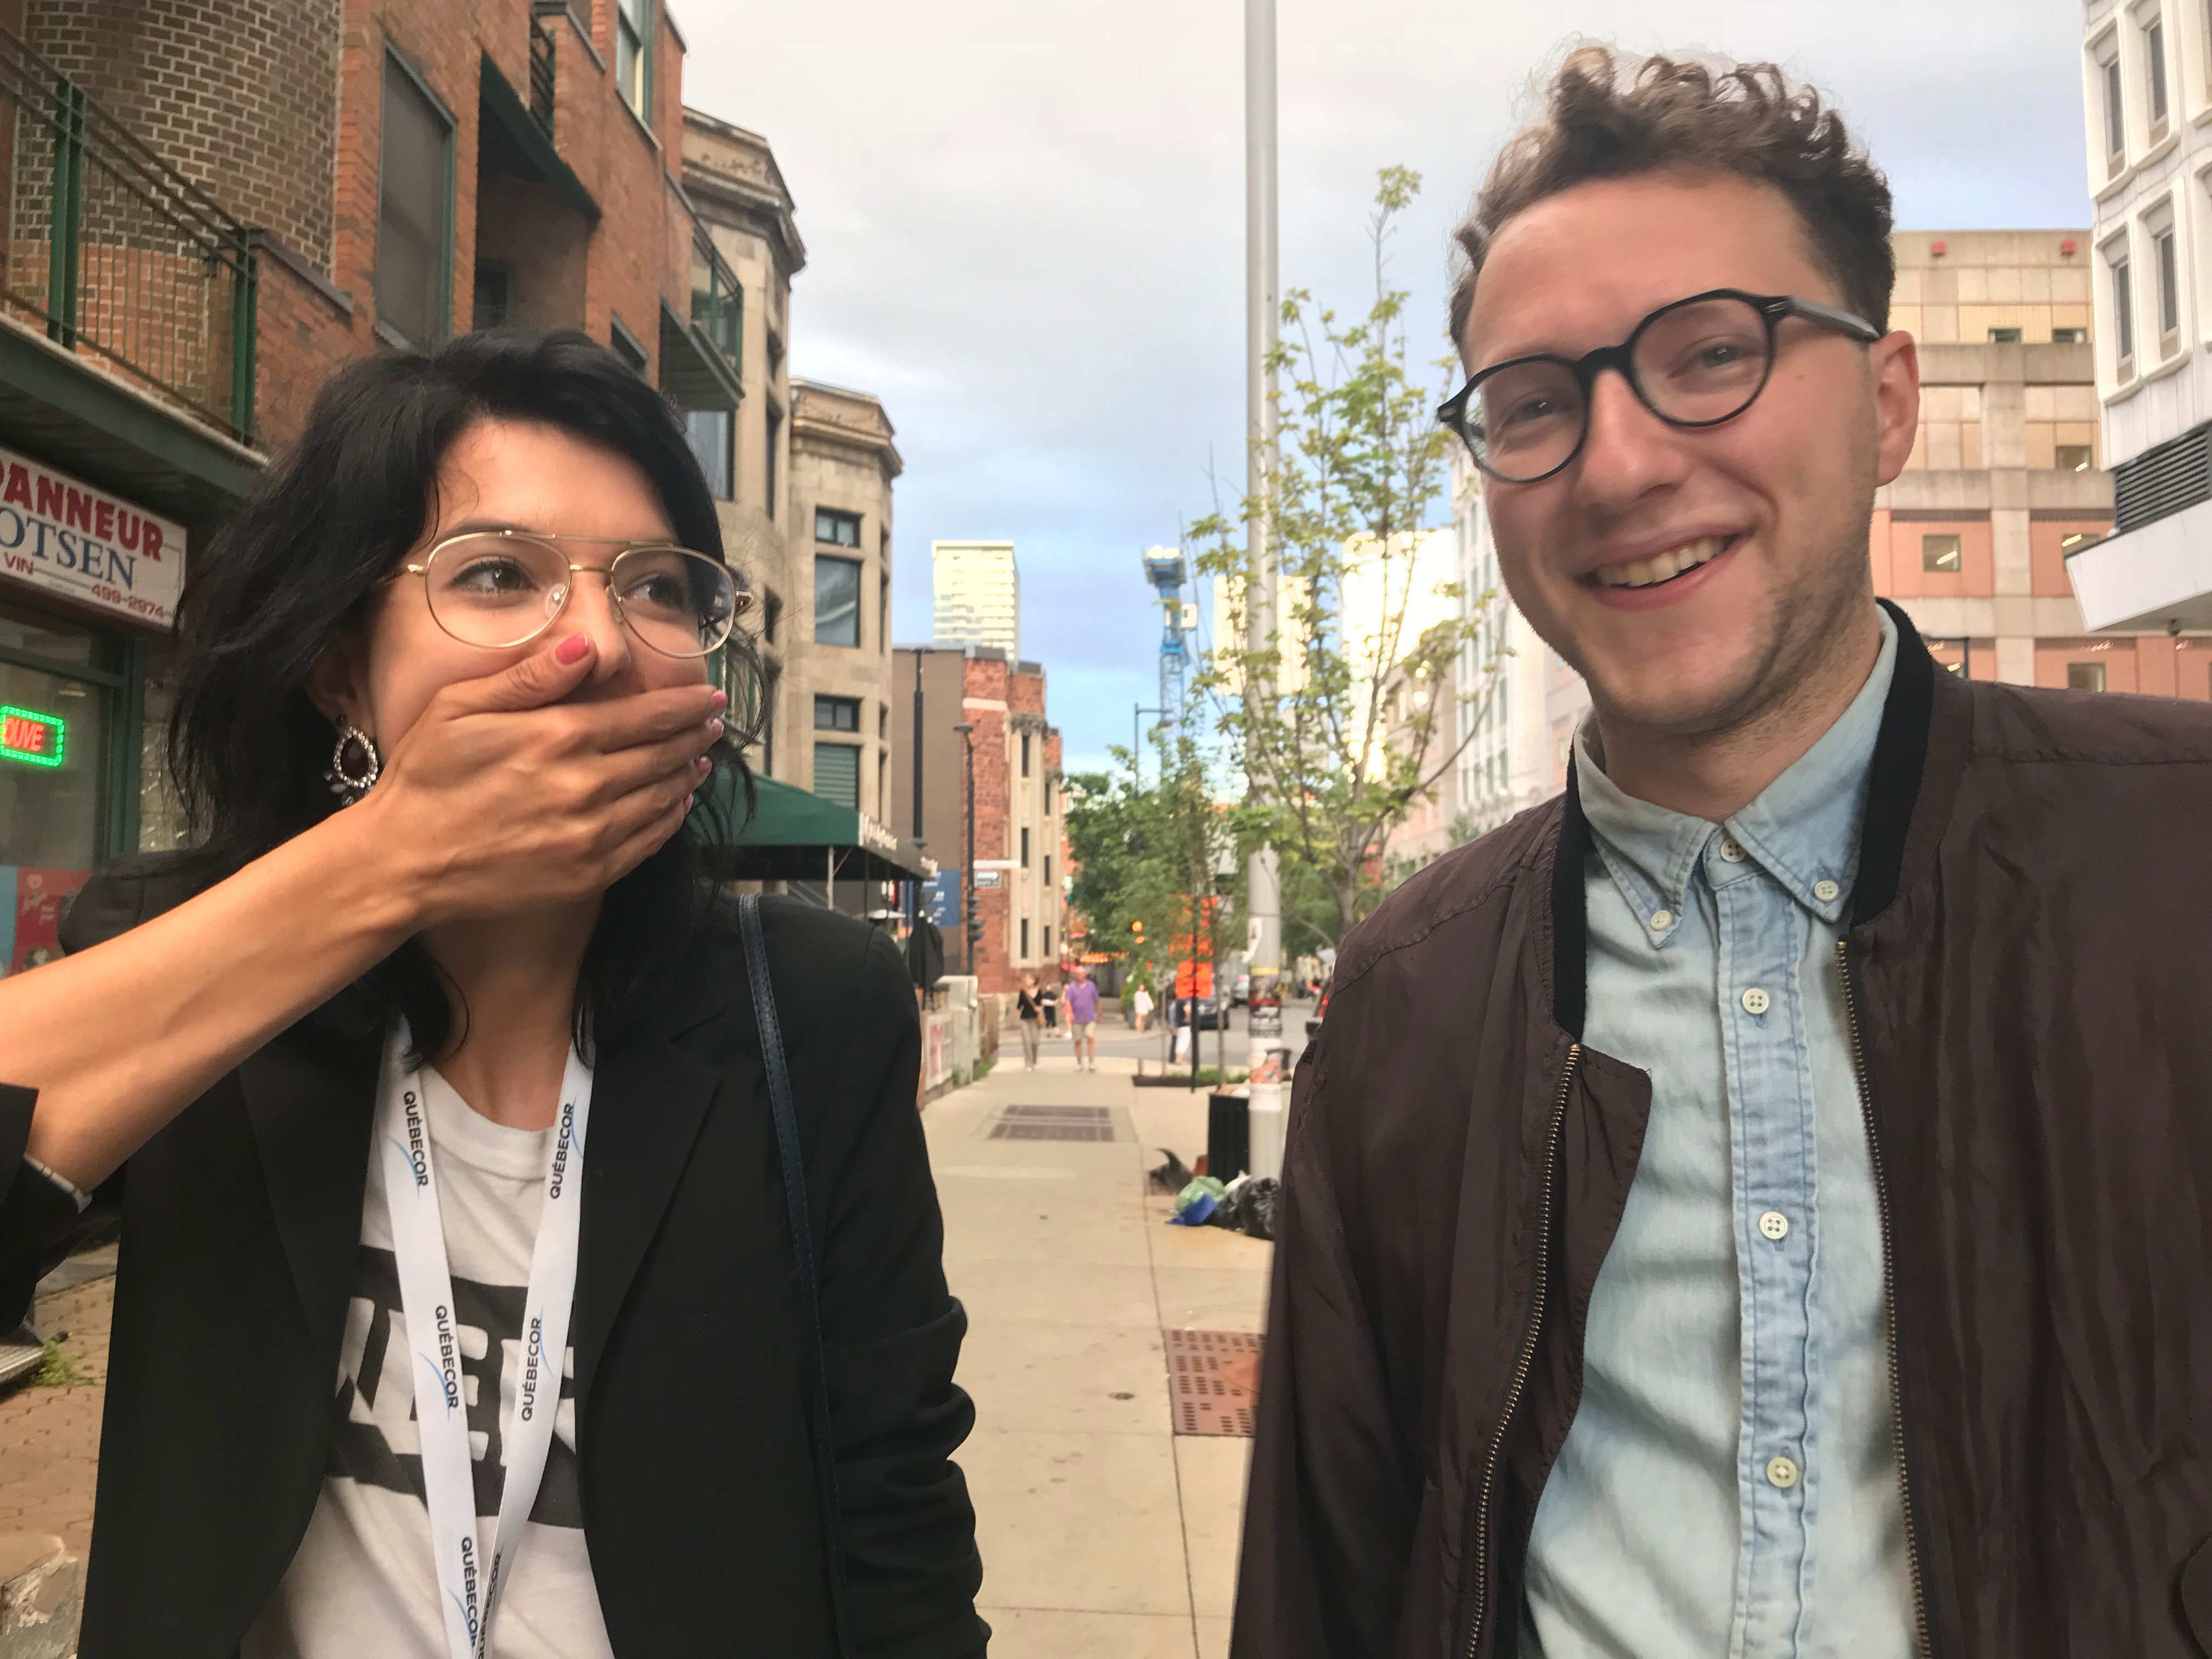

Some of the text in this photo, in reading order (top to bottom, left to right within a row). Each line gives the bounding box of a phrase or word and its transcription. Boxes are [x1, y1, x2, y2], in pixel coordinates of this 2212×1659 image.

[0, 461, 163, 561] ANNEUR
[0, 507, 137, 591] OTSEN
[4, 552, 34, 575] VIN
[404, 1091, 429, 1187] QUÉBECOR
[550, 1102, 574, 1200] QUÉBECOR
[435, 1305, 459, 1409] QUÉBECOR
[521, 1317, 541, 1423] QUÉBECOR
